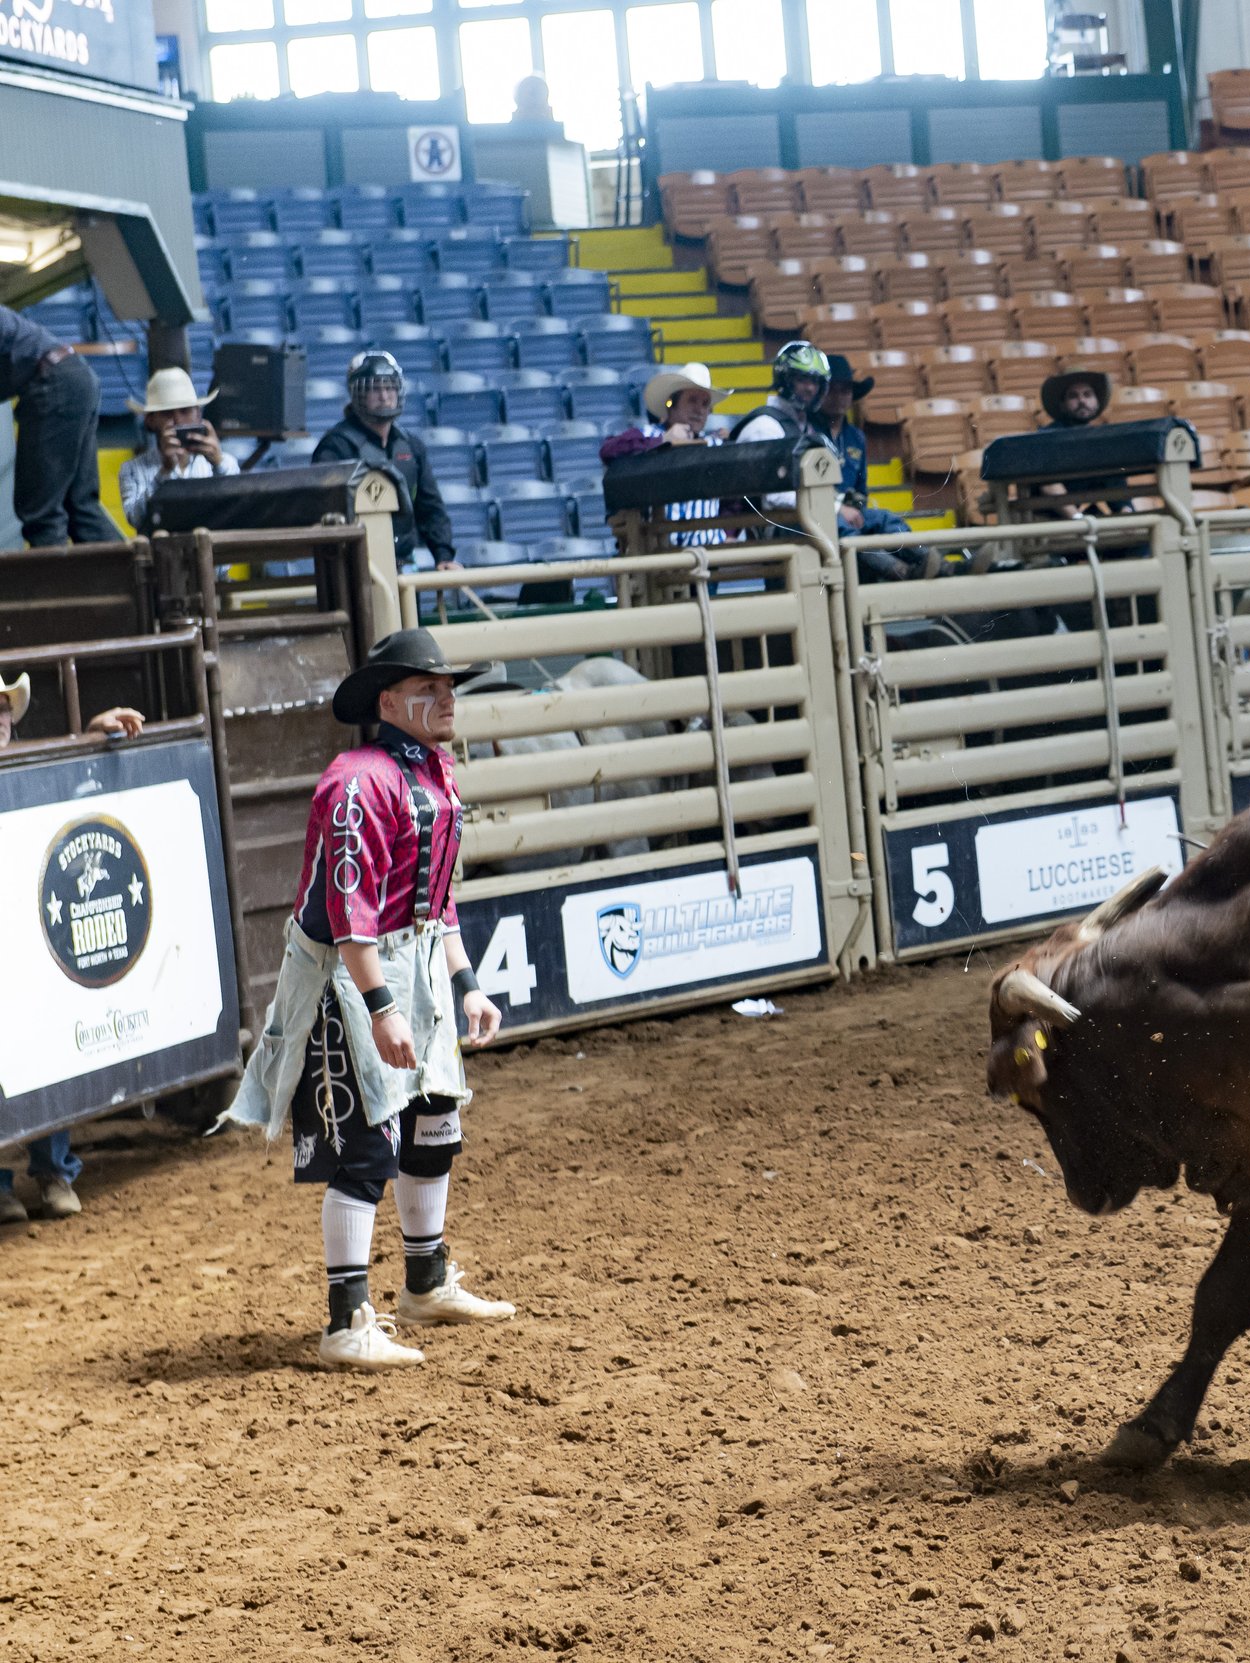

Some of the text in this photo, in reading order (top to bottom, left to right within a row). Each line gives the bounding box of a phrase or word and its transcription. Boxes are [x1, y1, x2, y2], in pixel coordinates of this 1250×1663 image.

[58, 832, 122, 872] STOCKYARDS
[1027, 852, 1135, 892] LUCCHESE
[911, 842, 955, 927] 5
[71, 909, 128, 957] RODEO
[643, 885, 793, 939] ULTIMATE
[474, 914, 537, 1006] 4
